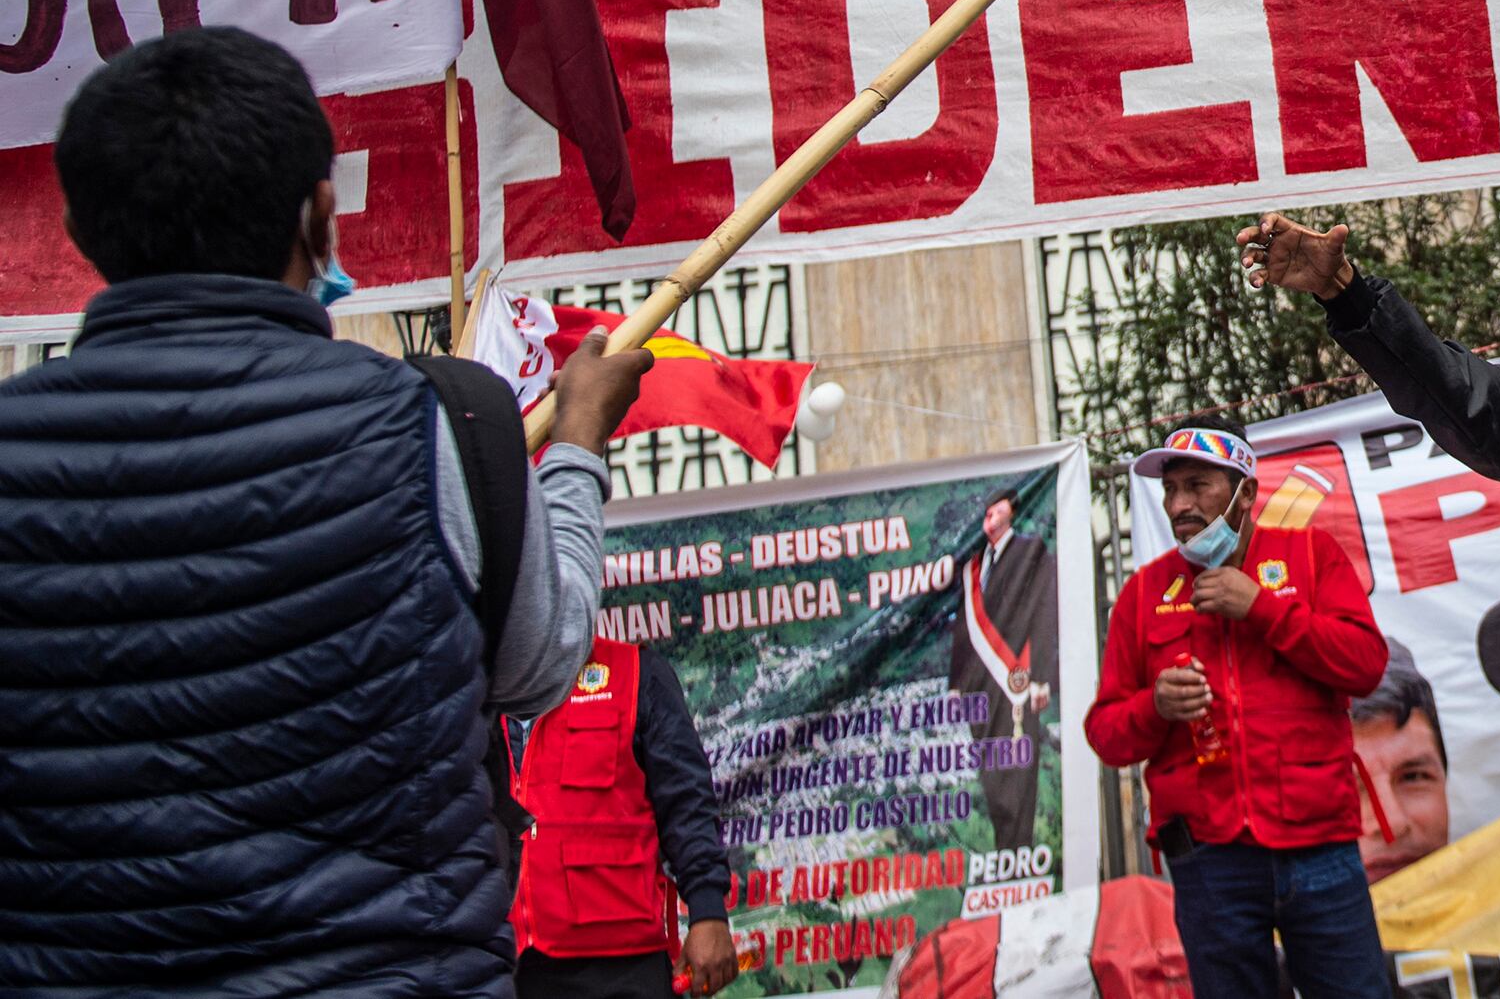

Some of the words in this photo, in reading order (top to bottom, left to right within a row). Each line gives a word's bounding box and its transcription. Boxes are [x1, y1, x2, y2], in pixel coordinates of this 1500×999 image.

[600, 541, 723, 589] NILLAS
[752, 516, 910, 568] DEUSTUA
[701, 578, 842, 633] JULIACA
[869, 554, 954, 609] PUNO
[792, 706, 882, 746] APOYAR
[891, 704, 902, 732] Y
[910, 691, 990, 728] EXIGIR
[771, 754, 876, 795] URGENTE
[883, 750, 911, 778] DE
[919, 734, 1033, 773] NUESTRO
[769, 802, 848, 840] PEDRO
[856, 790, 971, 830] CASTILLO
[747, 868, 783, 908] DE
[791, 847, 965, 903] AUTORIDAD
[968, 845, 1052, 884] PEDRO
[967, 880, 1051, 912] CASTILLO
[775, 914, 917, 965] PERUANO
